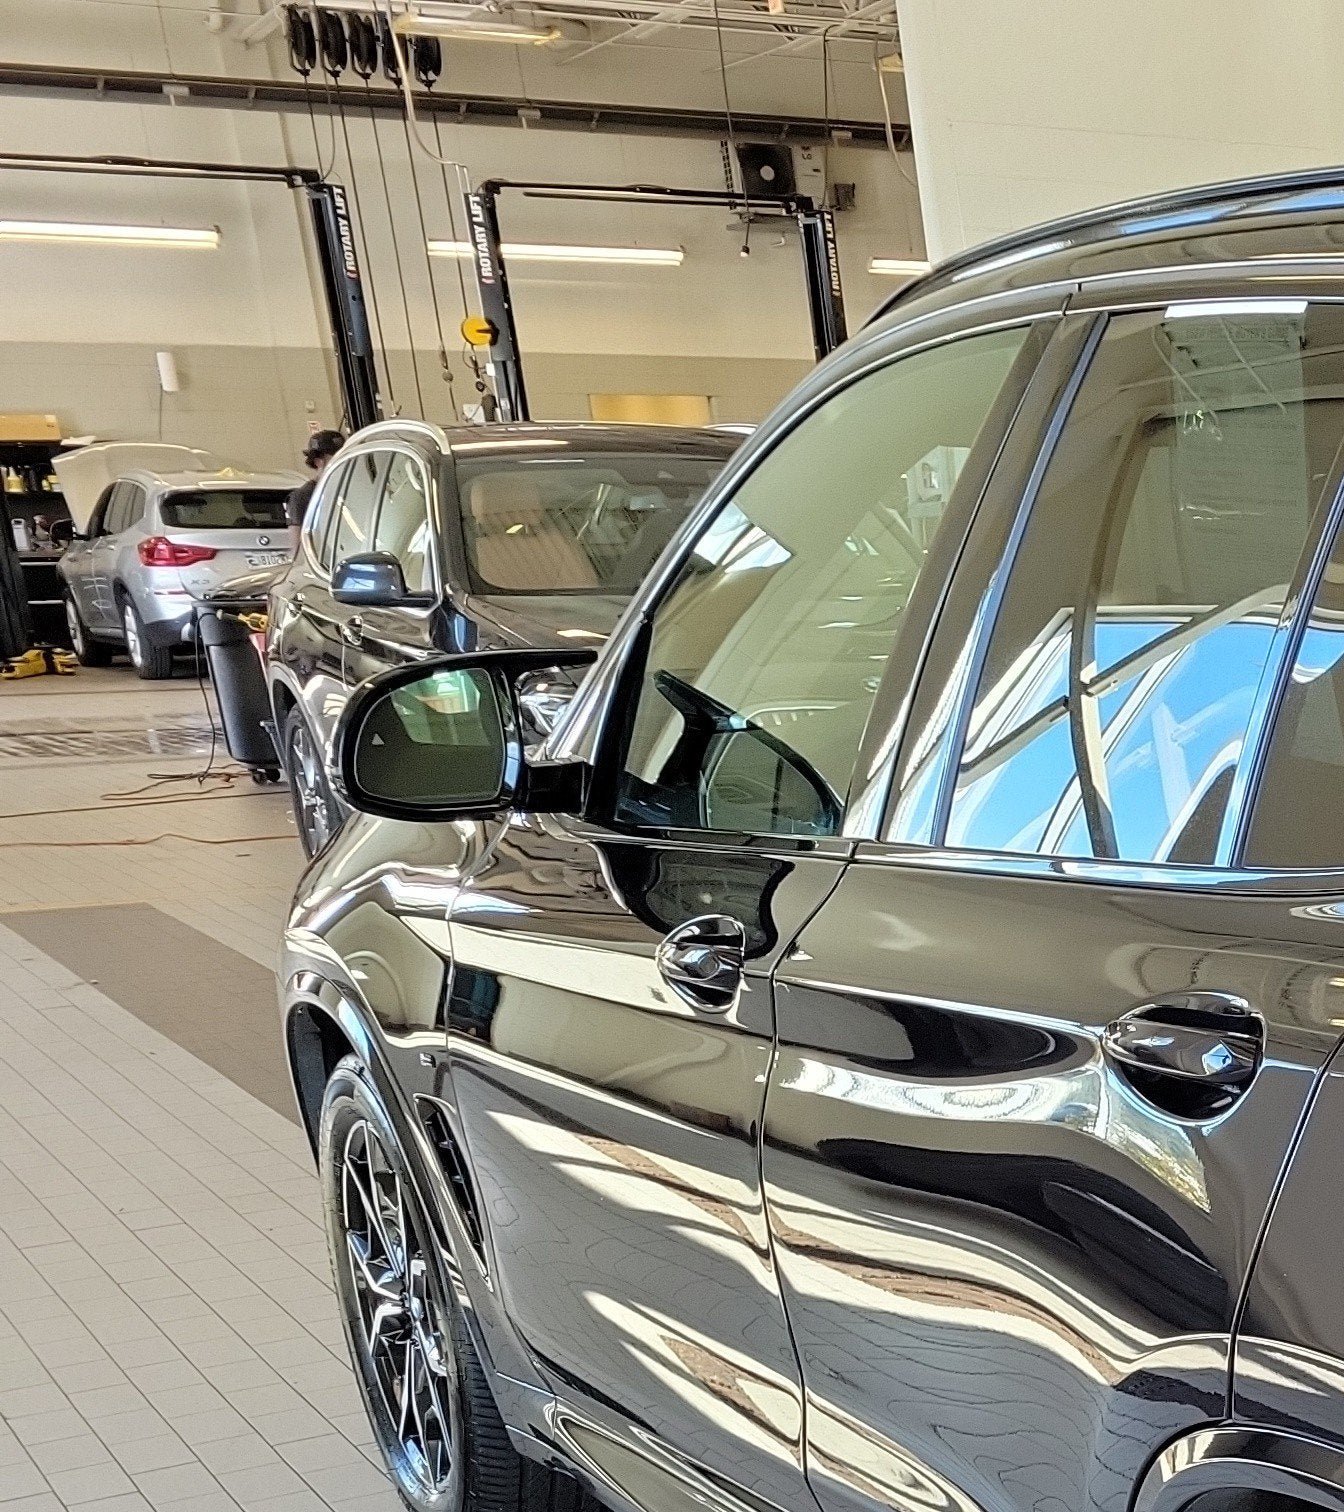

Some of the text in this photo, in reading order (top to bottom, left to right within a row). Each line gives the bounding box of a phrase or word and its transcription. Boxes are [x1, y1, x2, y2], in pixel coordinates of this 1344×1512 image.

[333, 186, 357, 272] ROTARY LIFT
[469, 195, 494, 278] ROTARY LIFT
